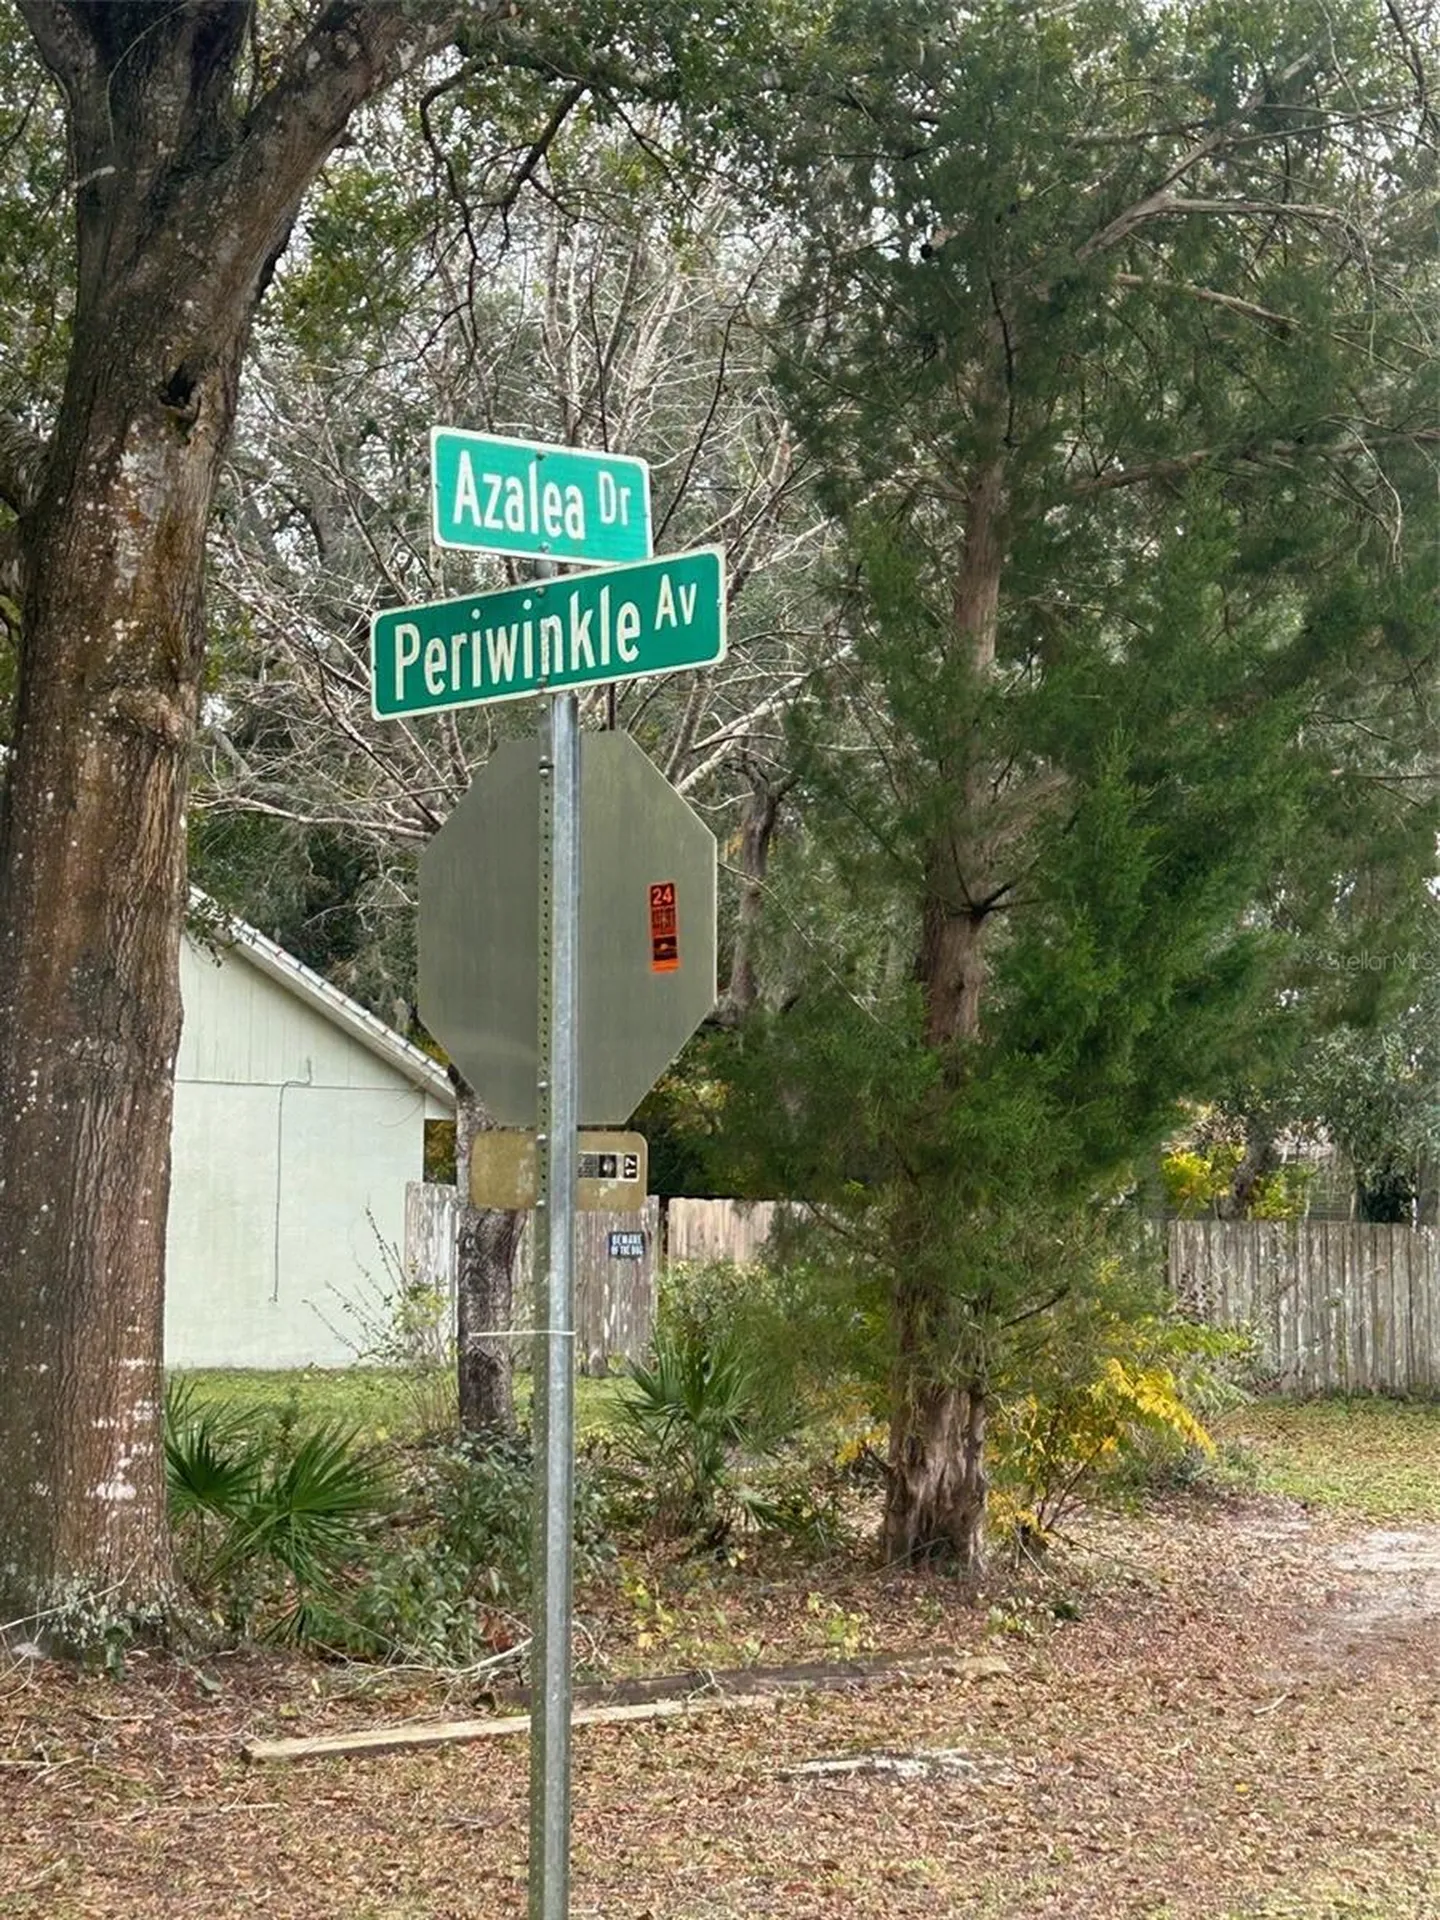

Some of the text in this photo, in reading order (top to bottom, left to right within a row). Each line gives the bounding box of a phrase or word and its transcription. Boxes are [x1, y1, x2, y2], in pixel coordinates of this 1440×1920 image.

[453, 450, 631, 540] Azalea Dr
[395, 574, 697, 700] Periwinkle Av
[652, 887, 673, 905] 24
[625, 1157, 636, 1176] 17
